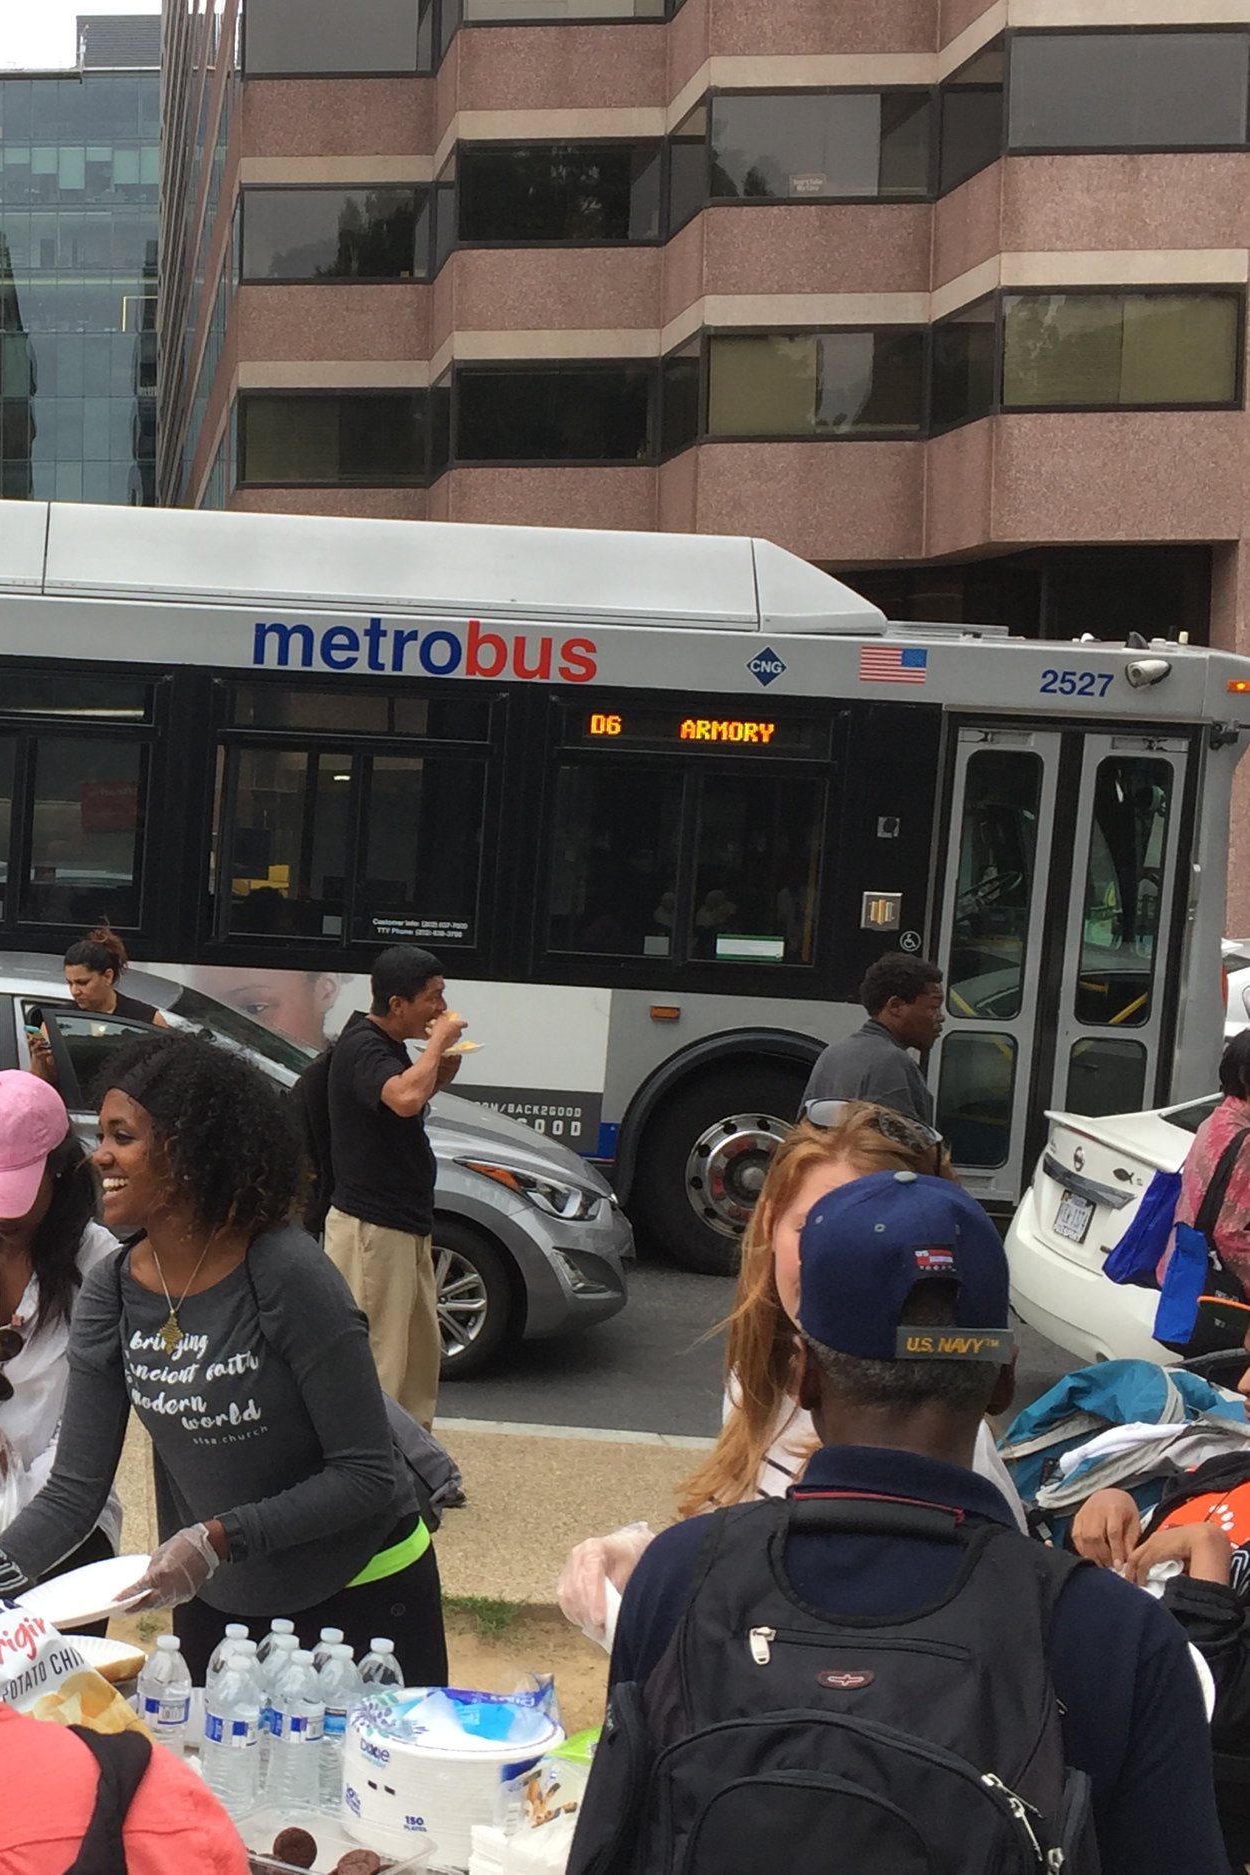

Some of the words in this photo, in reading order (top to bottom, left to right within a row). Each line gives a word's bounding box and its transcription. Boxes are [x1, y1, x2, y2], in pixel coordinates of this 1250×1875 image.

[253, 617, 598, 683] metrobus
[750, 658, 782, 675] CNG
[1039, 669, 1114, 697] 2527
[590, 714, 622, 735] D6
[680, 719, 775, 743] ARMORY
[906, 1336, 934, 1353] U.S.
[181, 1398, 262, 1431] world
[405, 1815, 424, 1826] 150
